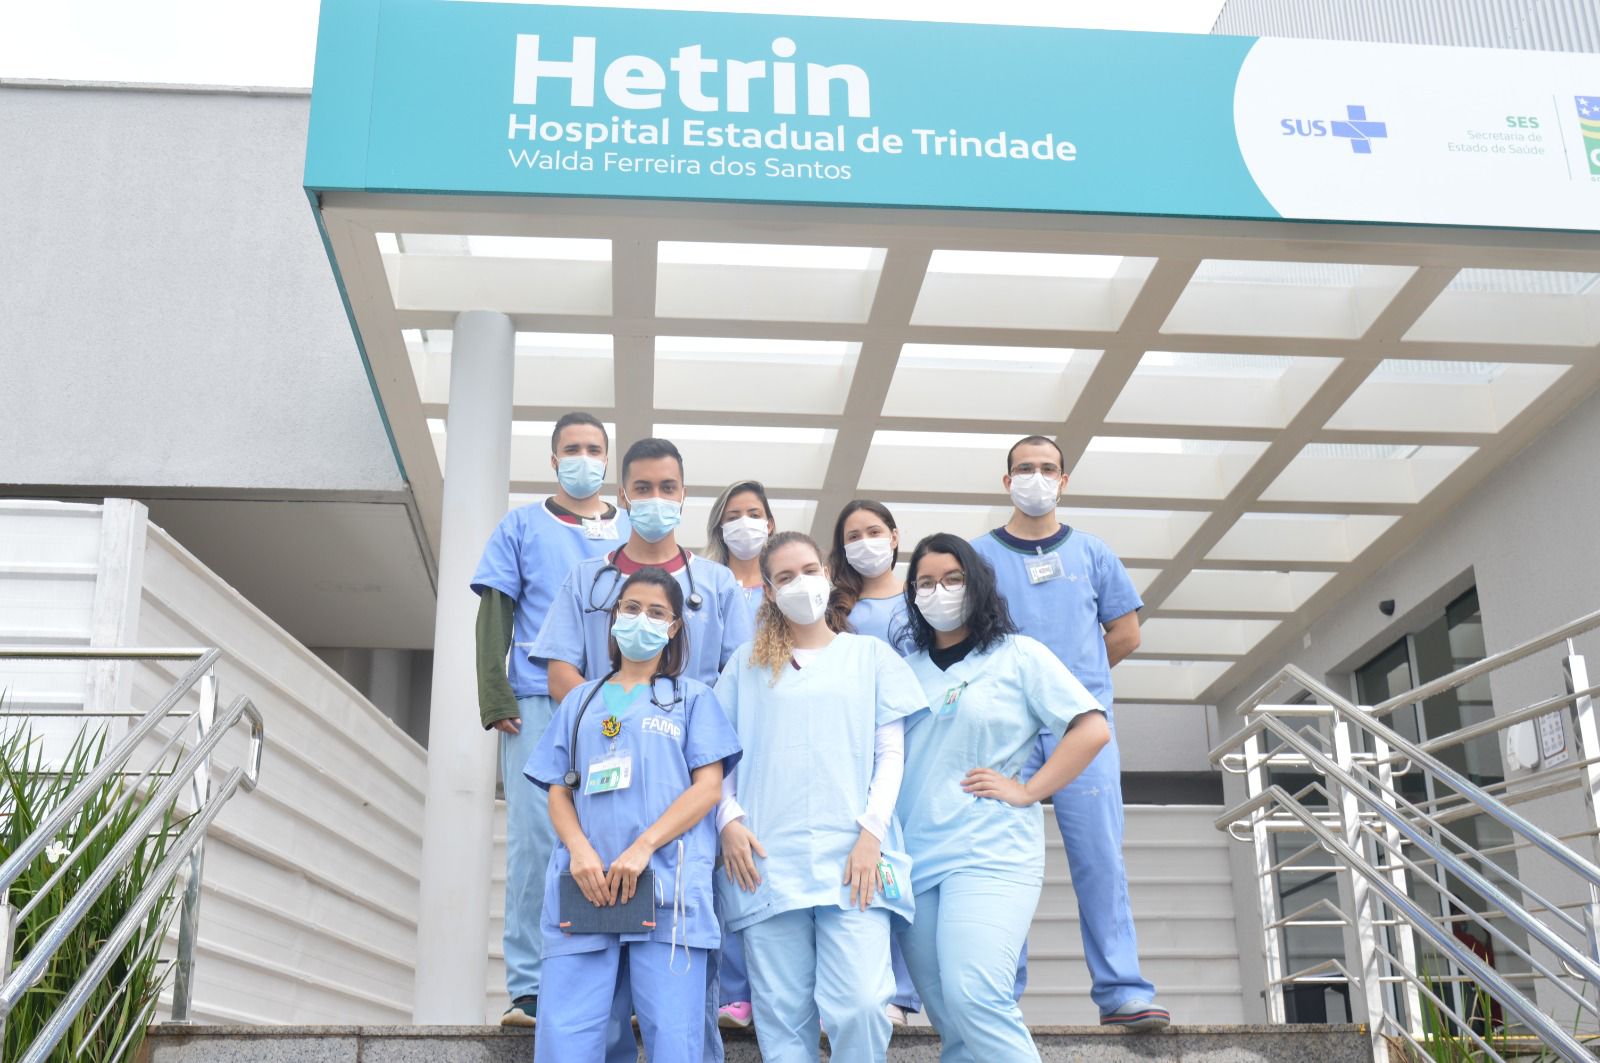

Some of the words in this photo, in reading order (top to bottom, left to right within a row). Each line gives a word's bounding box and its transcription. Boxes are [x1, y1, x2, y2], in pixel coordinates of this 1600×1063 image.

[512, 33, 871, 118] Hetrin
[1280, 118, 1327, 137] SUS
[1505, 116, 1540, 129] SES
[508, 113, 670, 150] Hospital
[683, 119, 845, 152] Estadual
[856, 126, 904, 154] de
[911, 128, 1077, 161] Trindade
[1466, 129, 1521, 143] Secretaria
[1527, 132, 1542, 143] de
[1447, 142, 1488, 154] Estado
[1492, 143, 1506, 154] de
[1508, 142, 1545, 156] Saúde
[508, 148, 594, 171] Walda
[603, 152, 701, 175] Ferreira
[709, 155, 756, 176] dos
[765, 157, 852, 180] Santos
